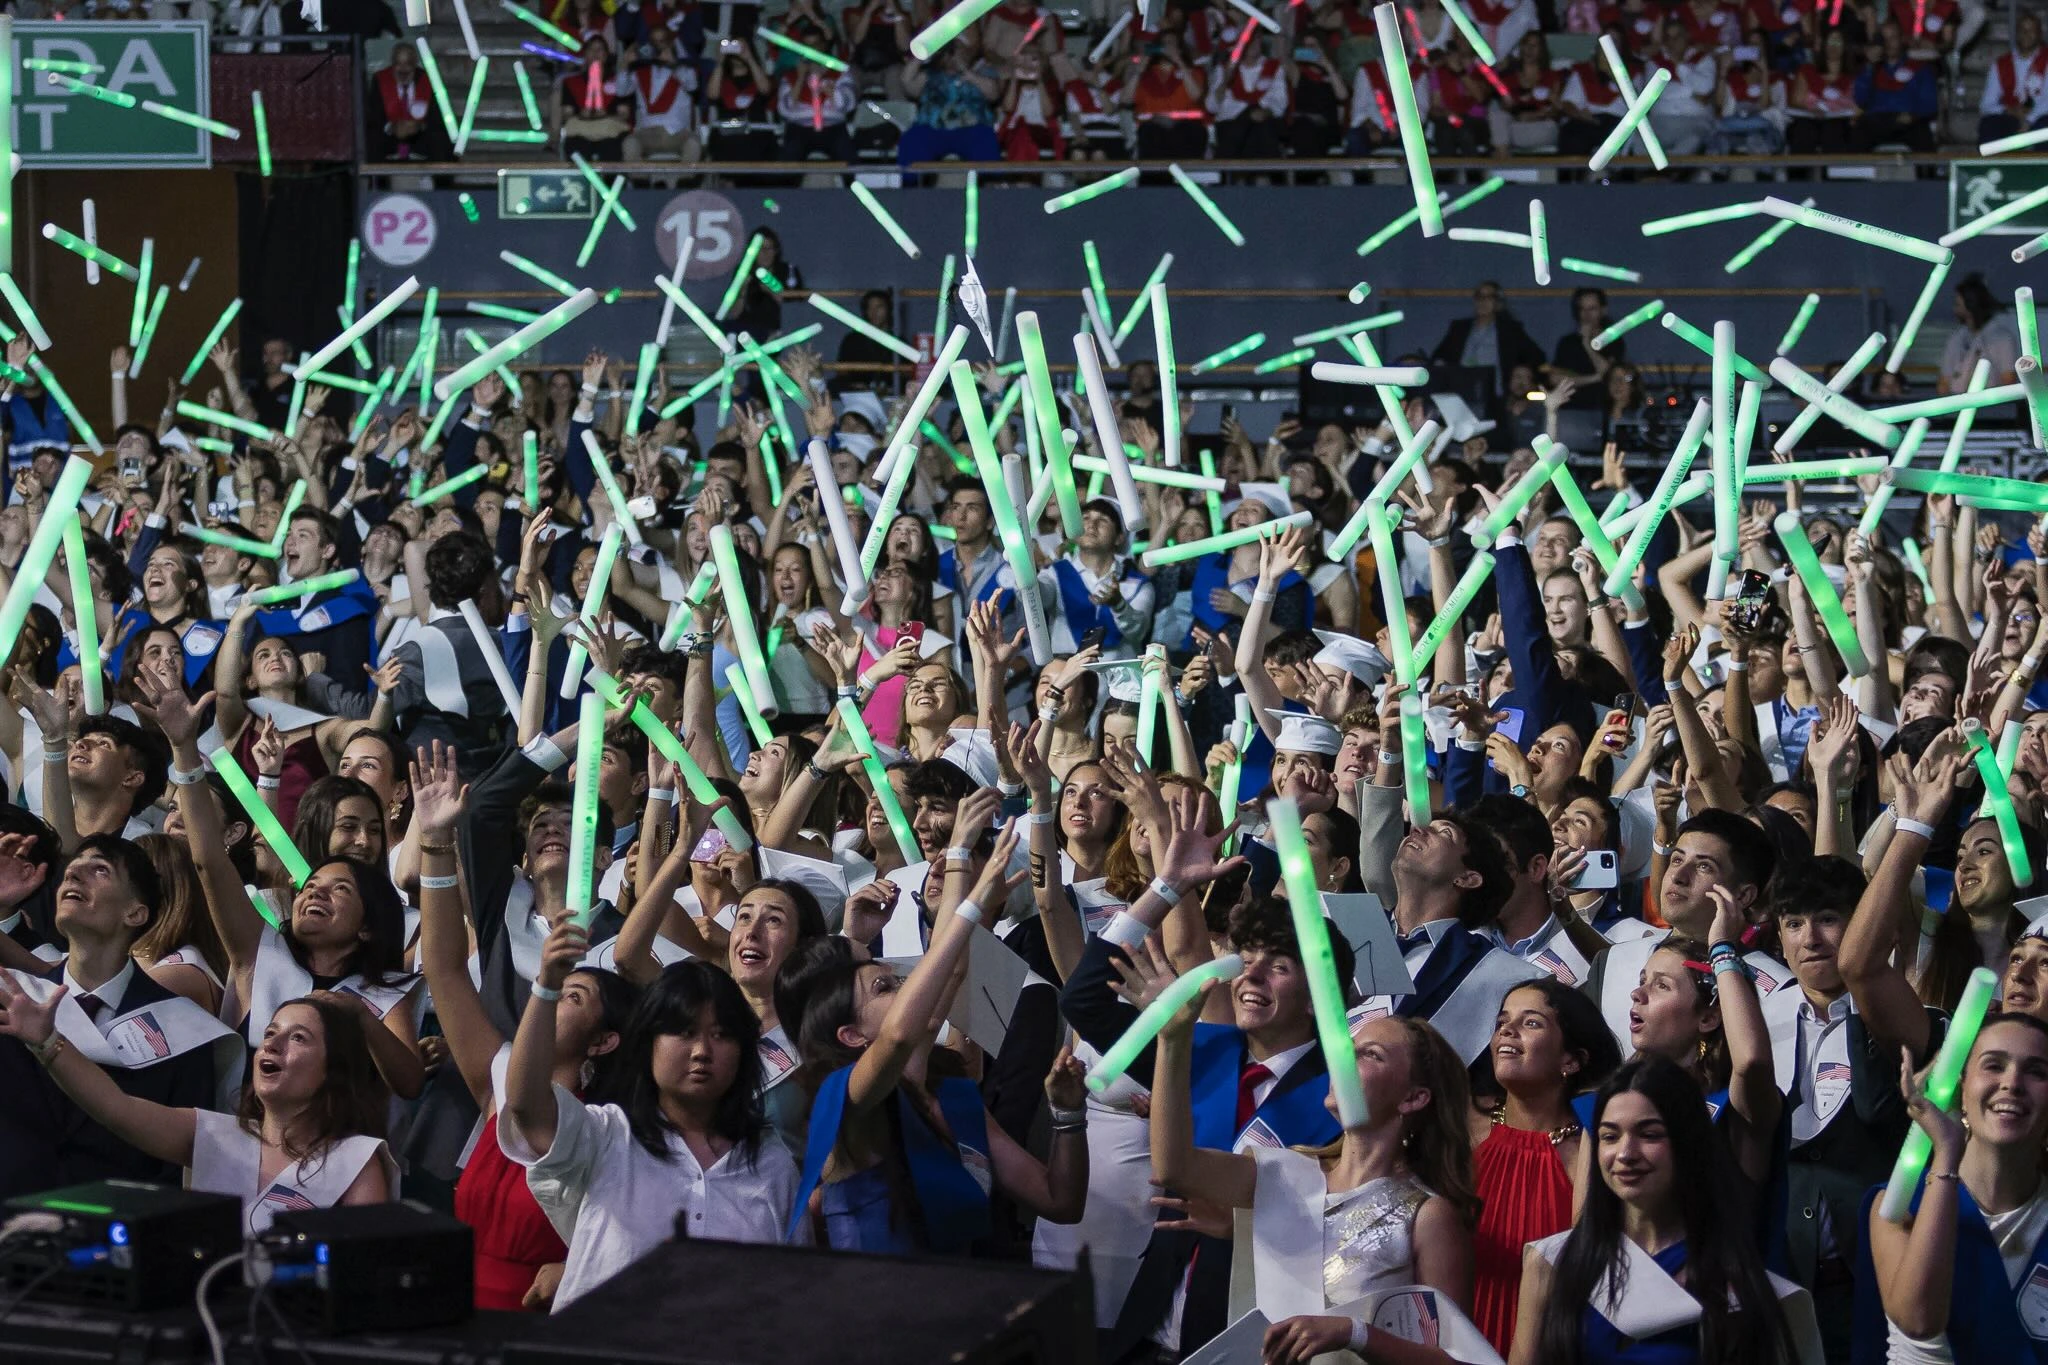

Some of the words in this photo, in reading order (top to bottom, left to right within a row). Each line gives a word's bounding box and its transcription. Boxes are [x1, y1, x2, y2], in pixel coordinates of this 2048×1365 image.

[373, 211, 429, 246] P2
[663, 209, 732, 262] 15
[1660, 445, 1697, 504] ACADEMICA
[1799, 469, 1855, 480] ACADEMIA
[1429, 585, 1465, 634] ACADEMICA
[586, 738, 600, 811] ACADEMICA
